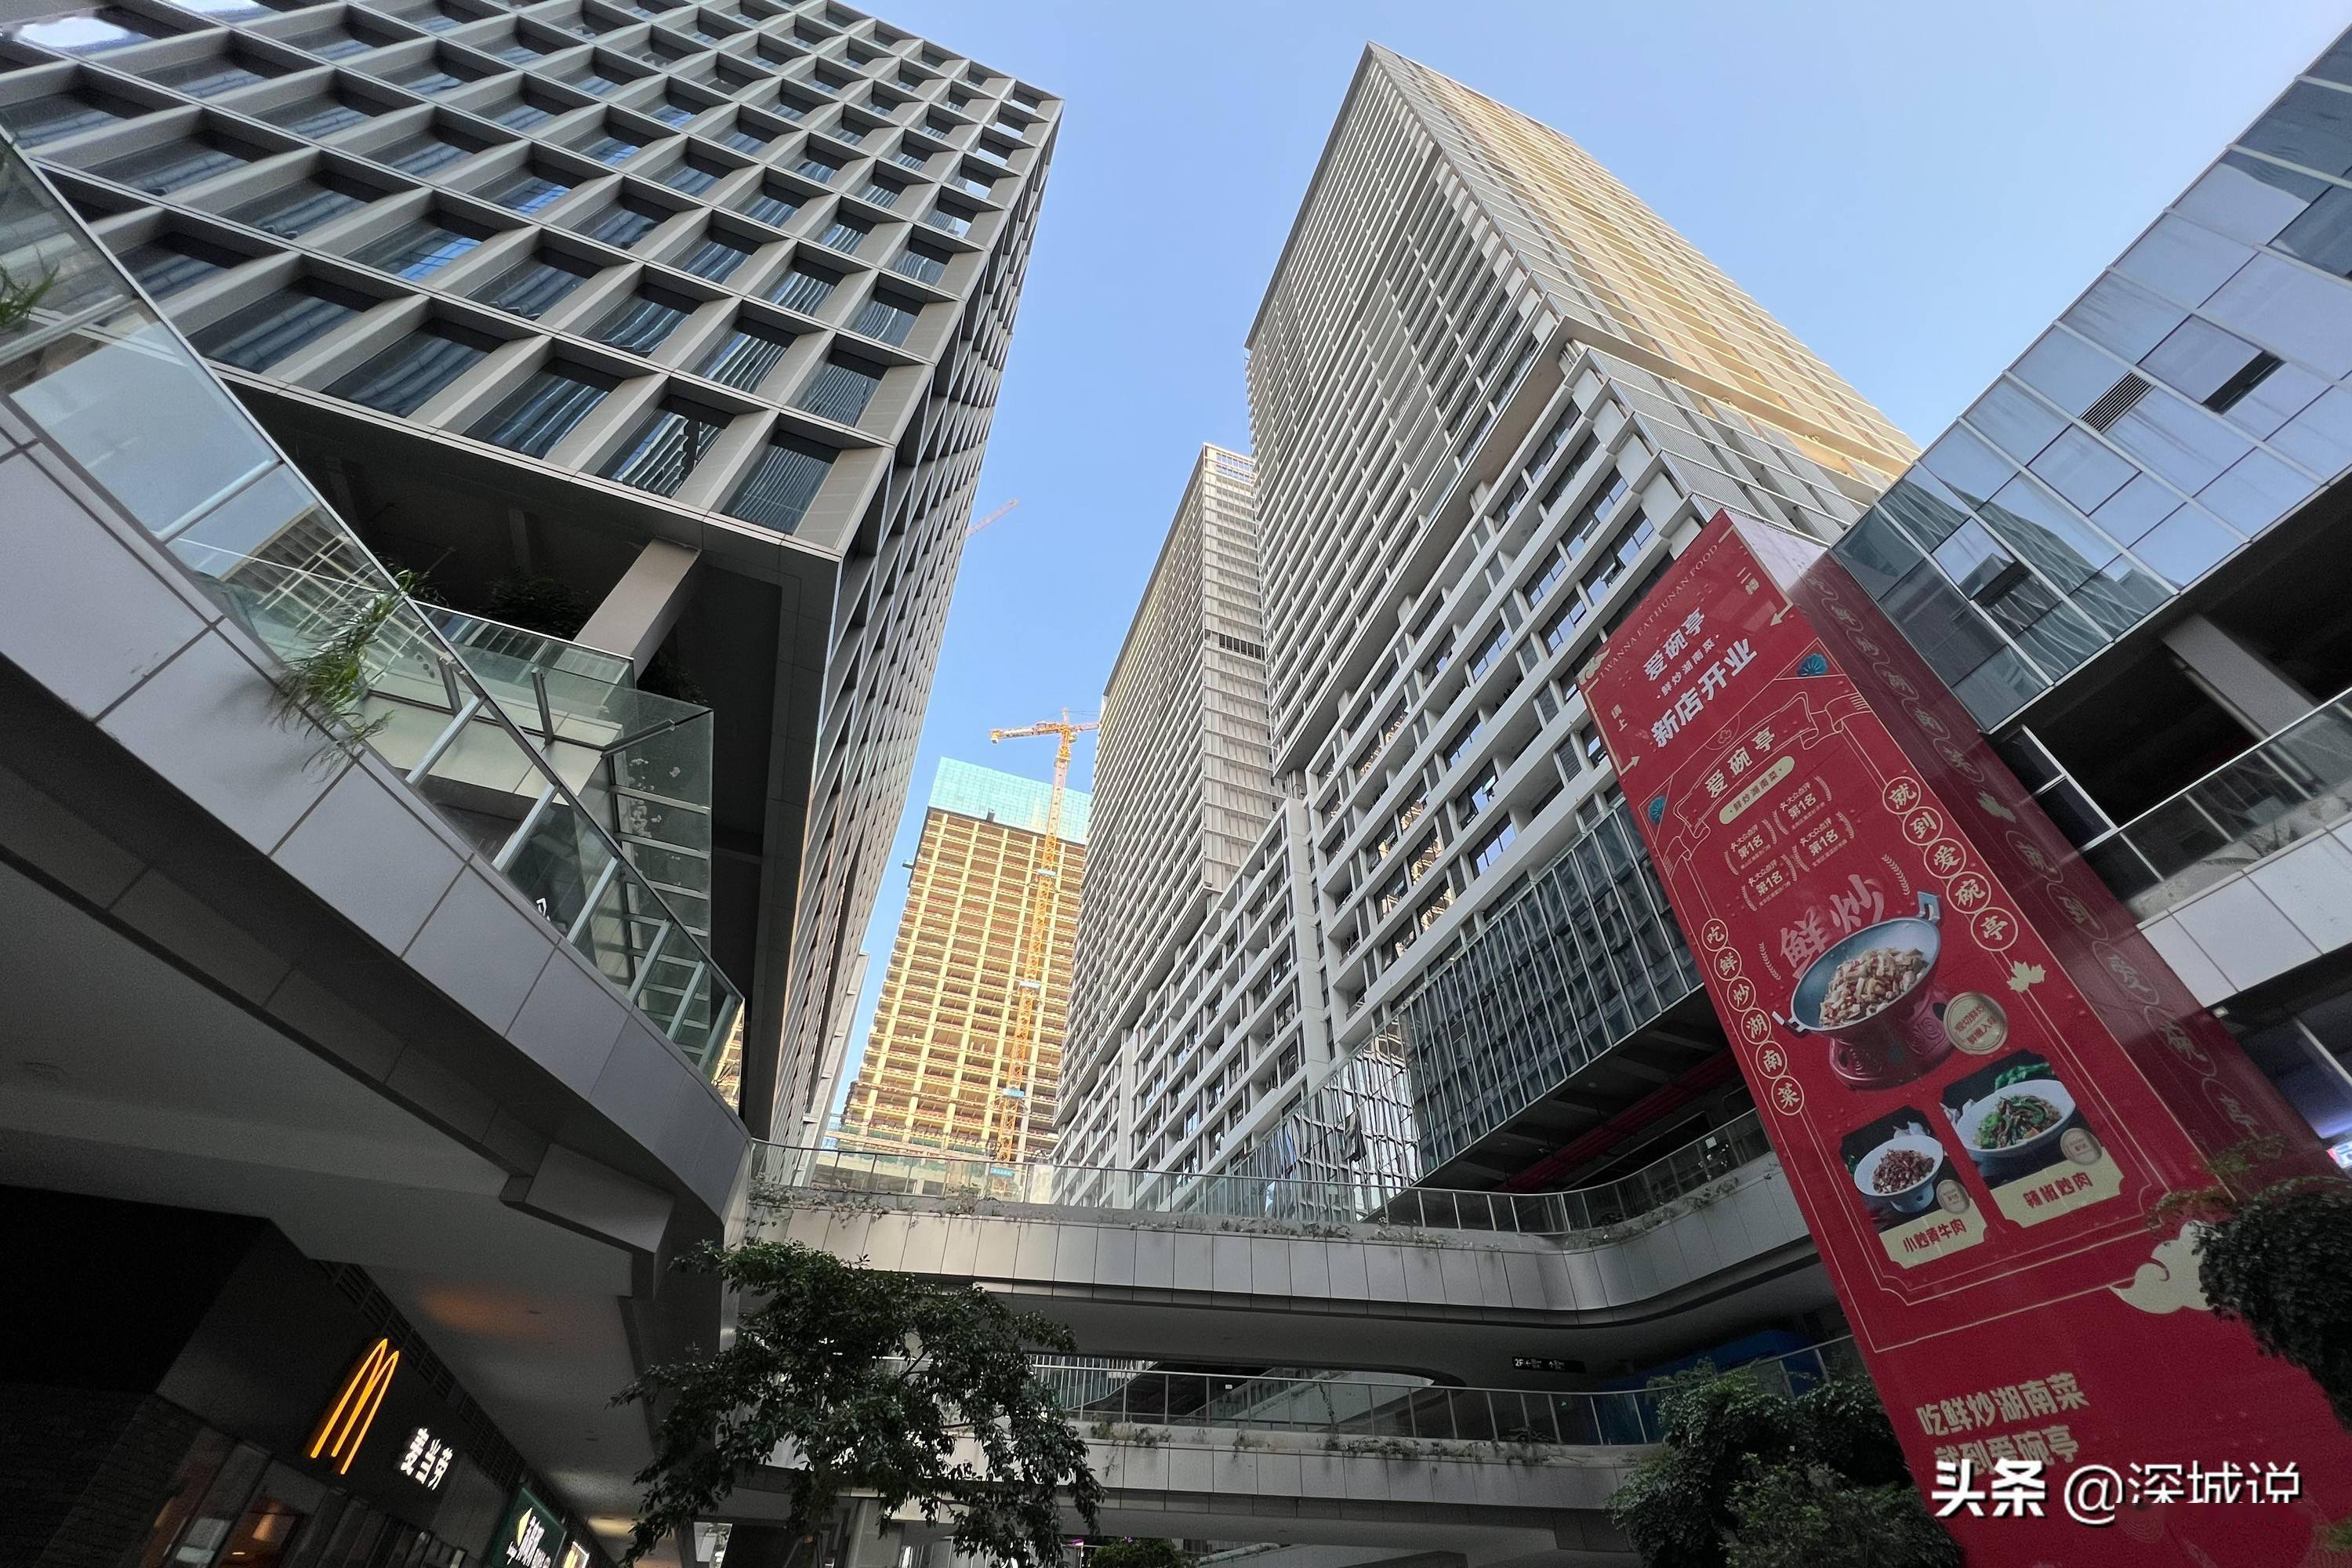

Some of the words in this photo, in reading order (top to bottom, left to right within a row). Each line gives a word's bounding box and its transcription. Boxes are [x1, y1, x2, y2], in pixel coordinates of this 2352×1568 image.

[1605, 637, 1637, 673] WANNA
[1689, 544, 1718, 578] FOOD
[1651, 638, 1758, 748] 新店开业
[1705, 726, 1775, 799] 爱碗亭
[1788, 793, 1817, 820] 第1名
[1738, 834, 1763, 860] 第1名
[1808, 829, 1838, 857] 第1名
[1888, 783, 2009, 941] 就到爱碗亭
[1755, 870, 1783, 897] 第1名
[1780, 873, 1884, 979] 鲜炒
[1706, 924, 1800, 1109] 吃鲜炒湖南菜
[1916, 1372, 2090, 1436] 吃鲜炒湖南菜
[400, 1428, 453, 1490] 麦当劳
